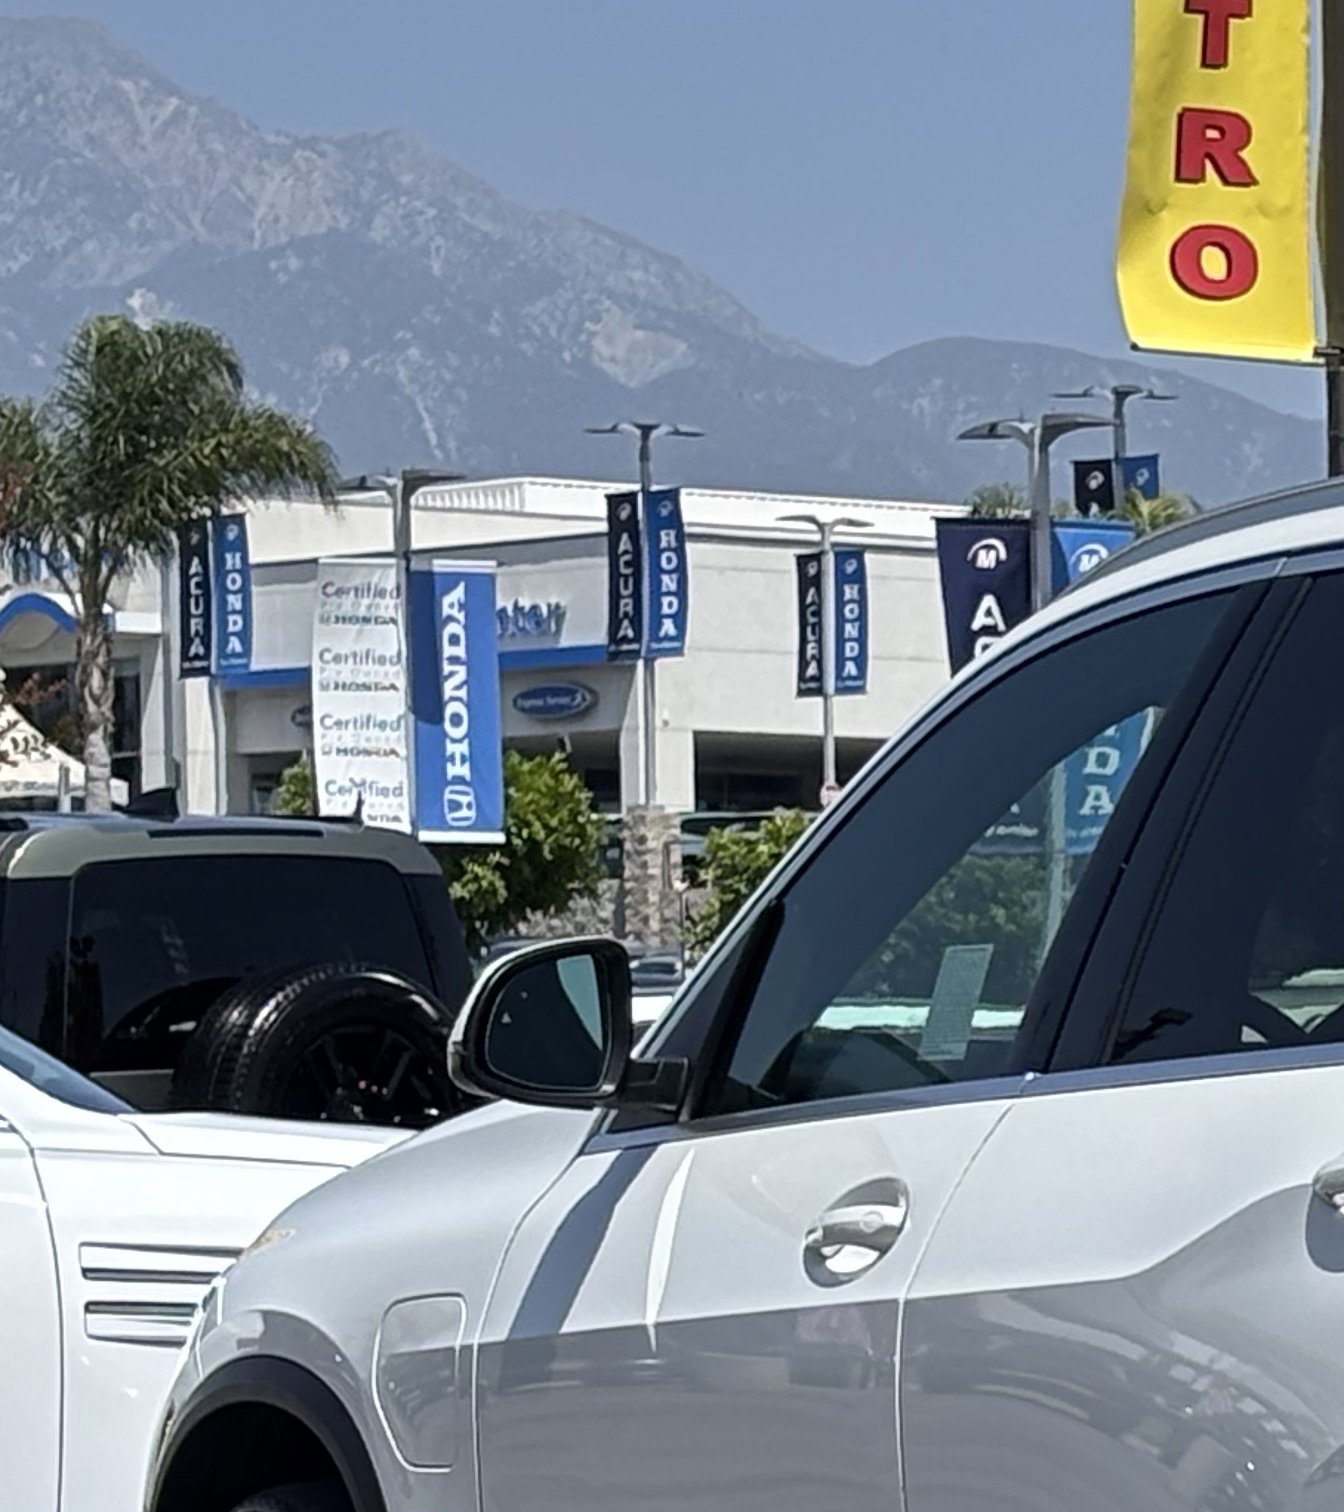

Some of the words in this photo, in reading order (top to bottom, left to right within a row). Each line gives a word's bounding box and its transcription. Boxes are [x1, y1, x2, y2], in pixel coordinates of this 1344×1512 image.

[188, 555, 205, 658] ACURA
[224, 551, 244, 654] HONDA
[321, 580, 400, 600] Certified
[617, 532, 635, 640] ACURA
[658, 529, 679, 638] HONDA
[319, 648, 400, 667] Certified
[805, 586, 820, 678] ACURA
[842, 583, 860, 678] HONDA
[320, 713, 401, 732] Certified
[442, 580, 472, 781] HONDA
[325, 780, 403, 798] Cerified
[1079, 725, 1121, 815] DA
